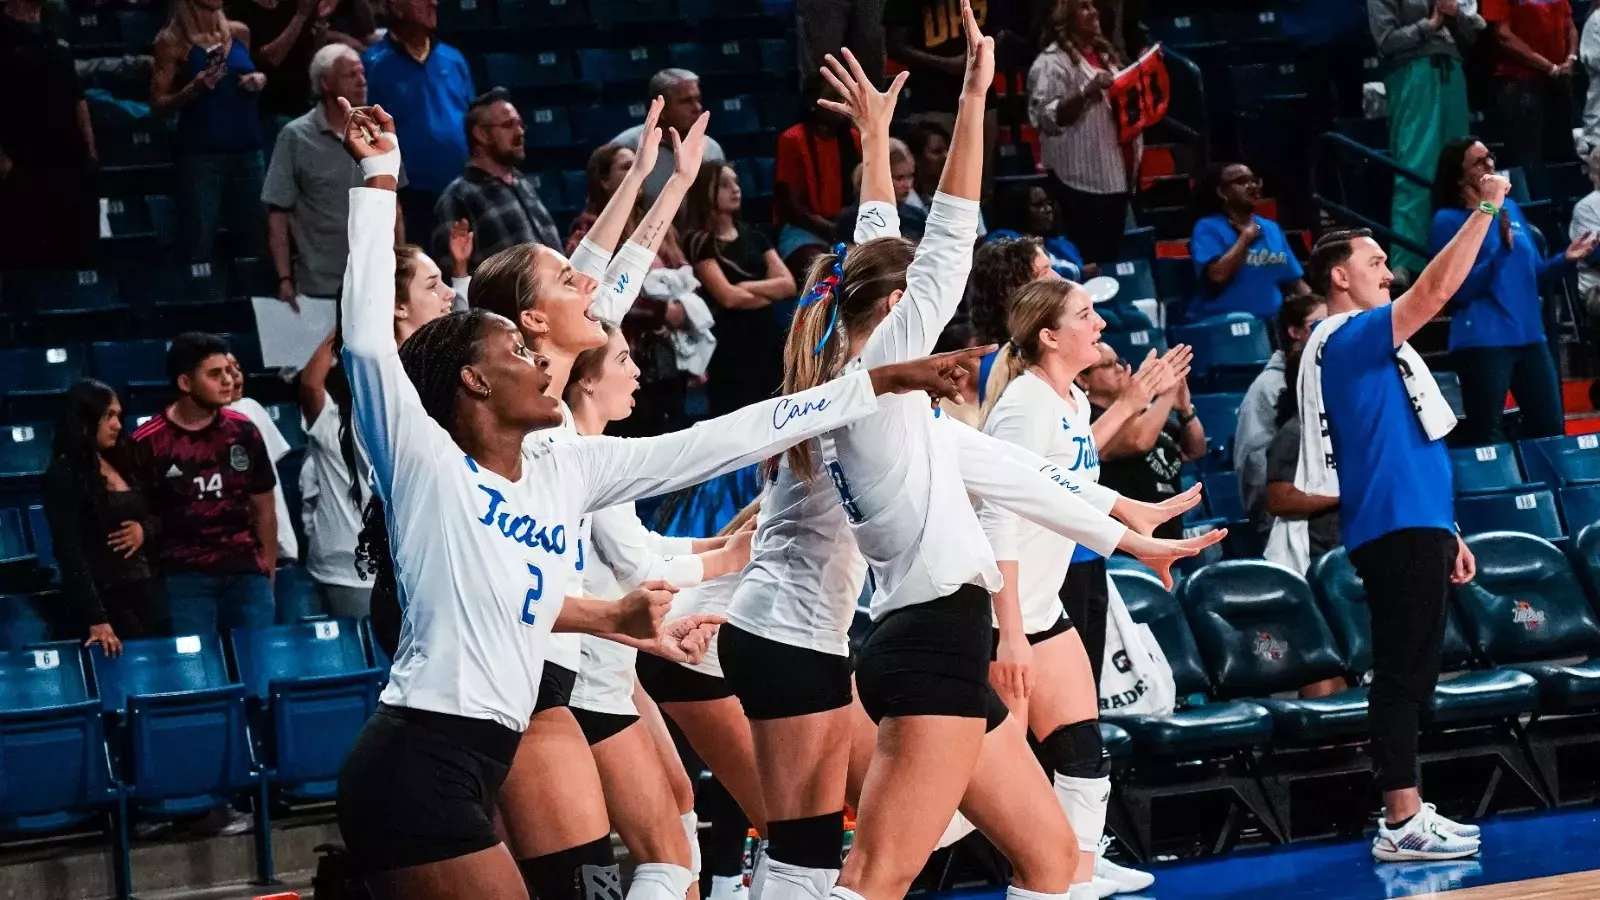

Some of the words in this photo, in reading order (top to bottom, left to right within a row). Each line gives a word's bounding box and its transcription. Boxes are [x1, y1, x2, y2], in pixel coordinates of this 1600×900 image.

[773, 398, 832, 430] Cane
[193, 473, 223, 500] 14
[521, 562, 544, 626] 2
[1100, 679, 1149, 711] RADE
